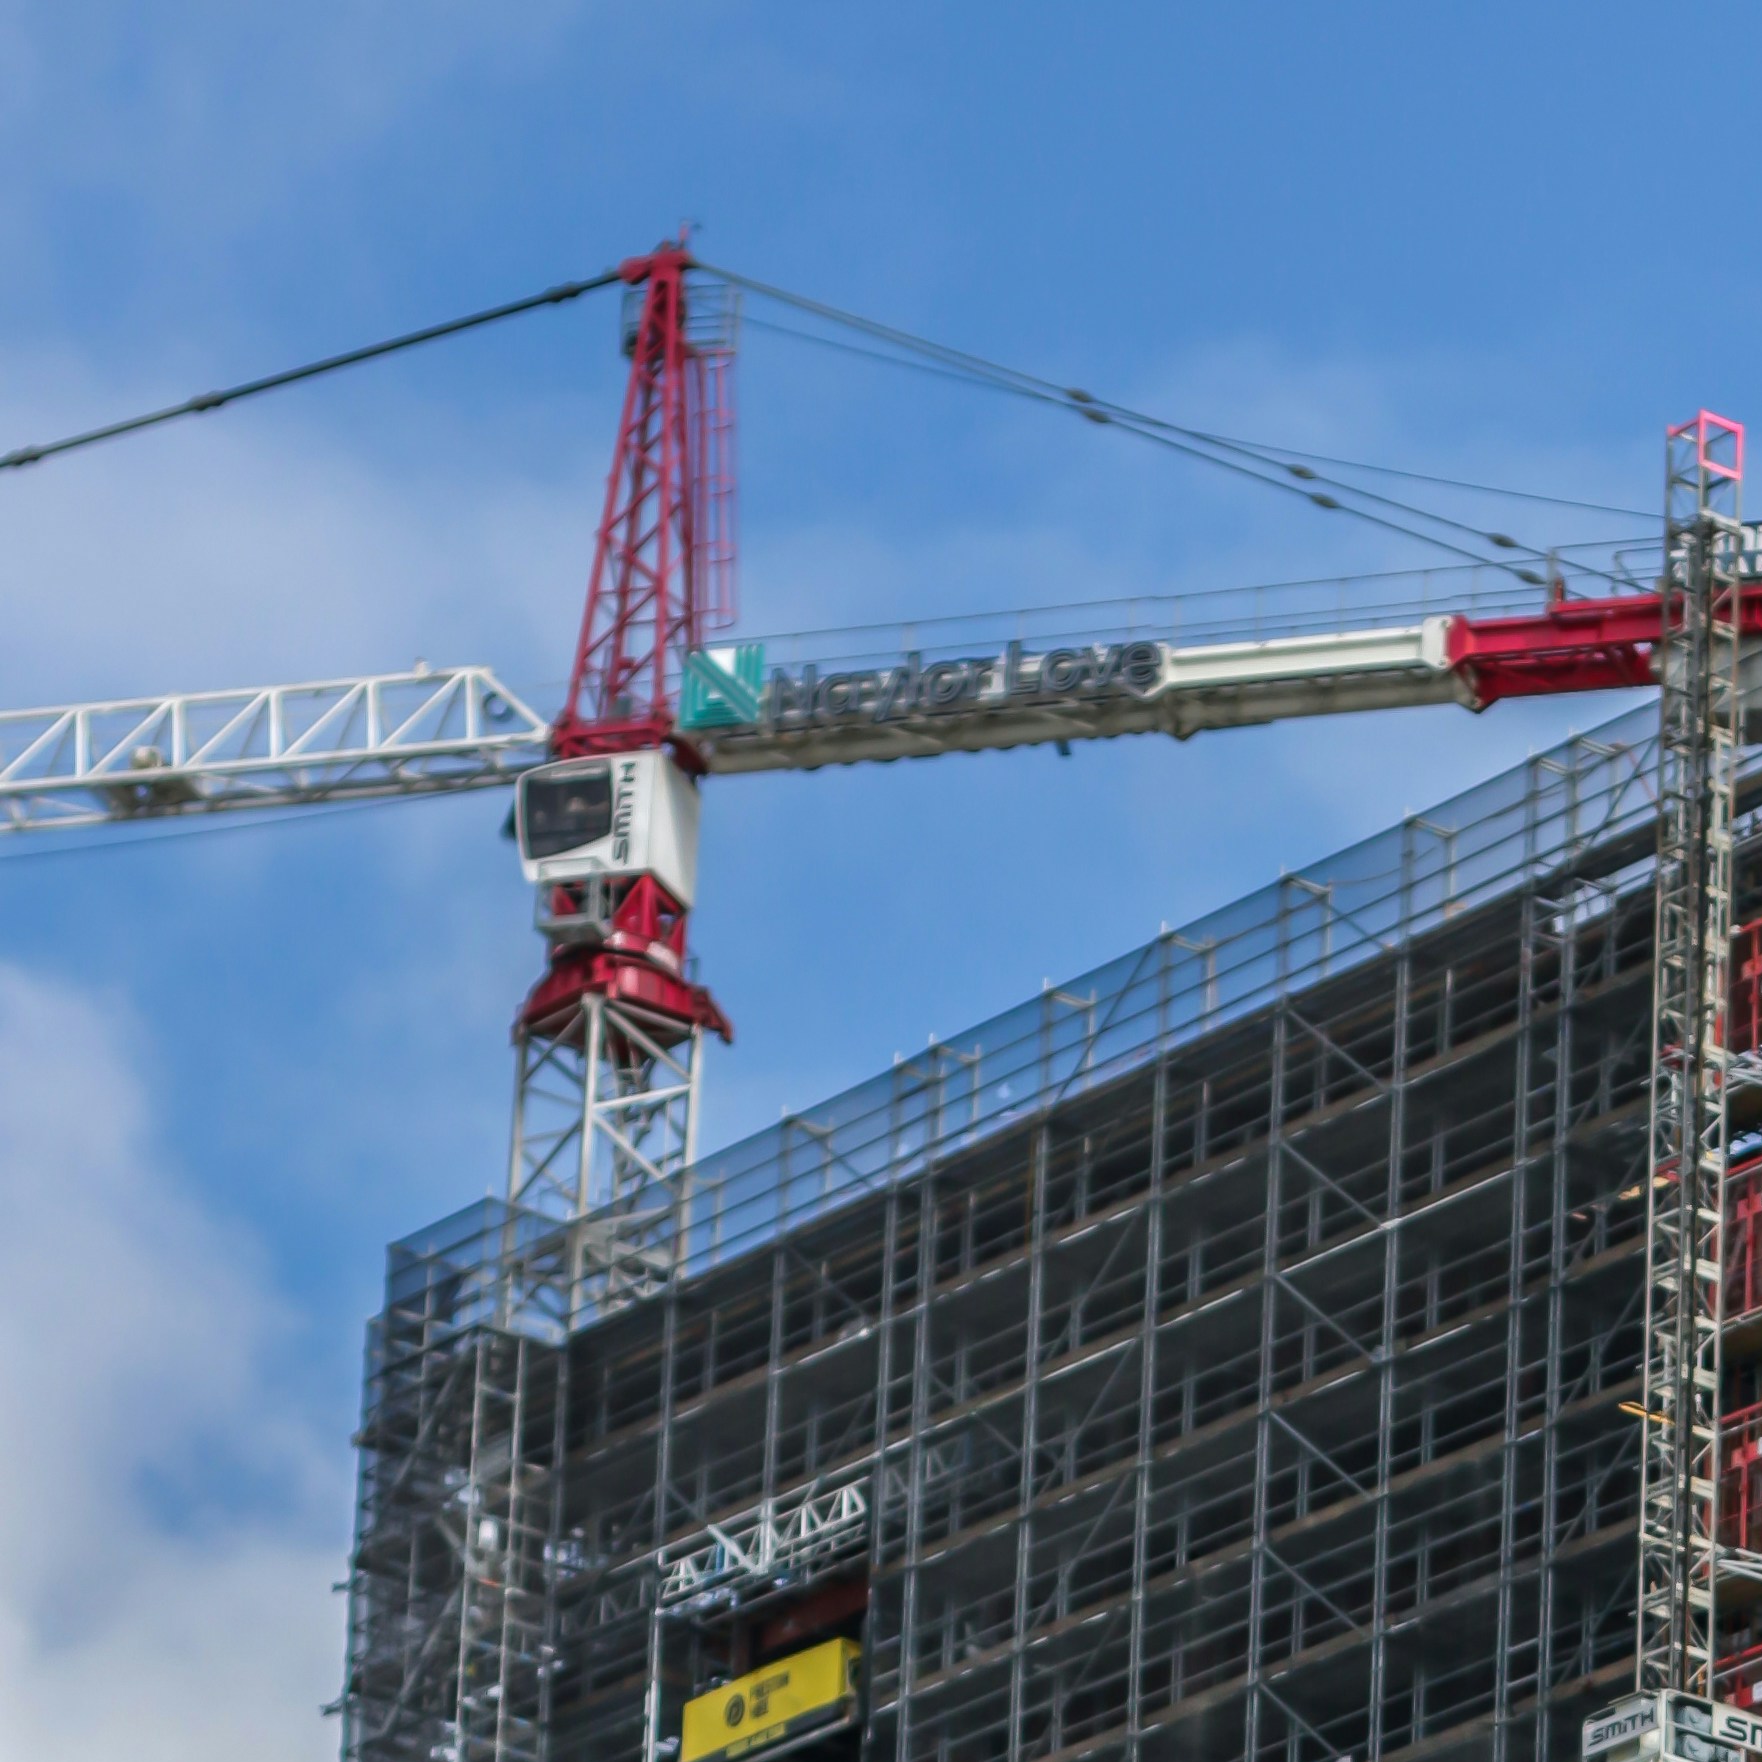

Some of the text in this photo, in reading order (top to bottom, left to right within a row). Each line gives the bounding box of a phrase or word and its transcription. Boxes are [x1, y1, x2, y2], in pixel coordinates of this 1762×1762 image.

[770, 651, 993, 726] Naylor
[1006, 640, 1162, 694] Love
[1588, 1707, 1654, 1746] SMITH
